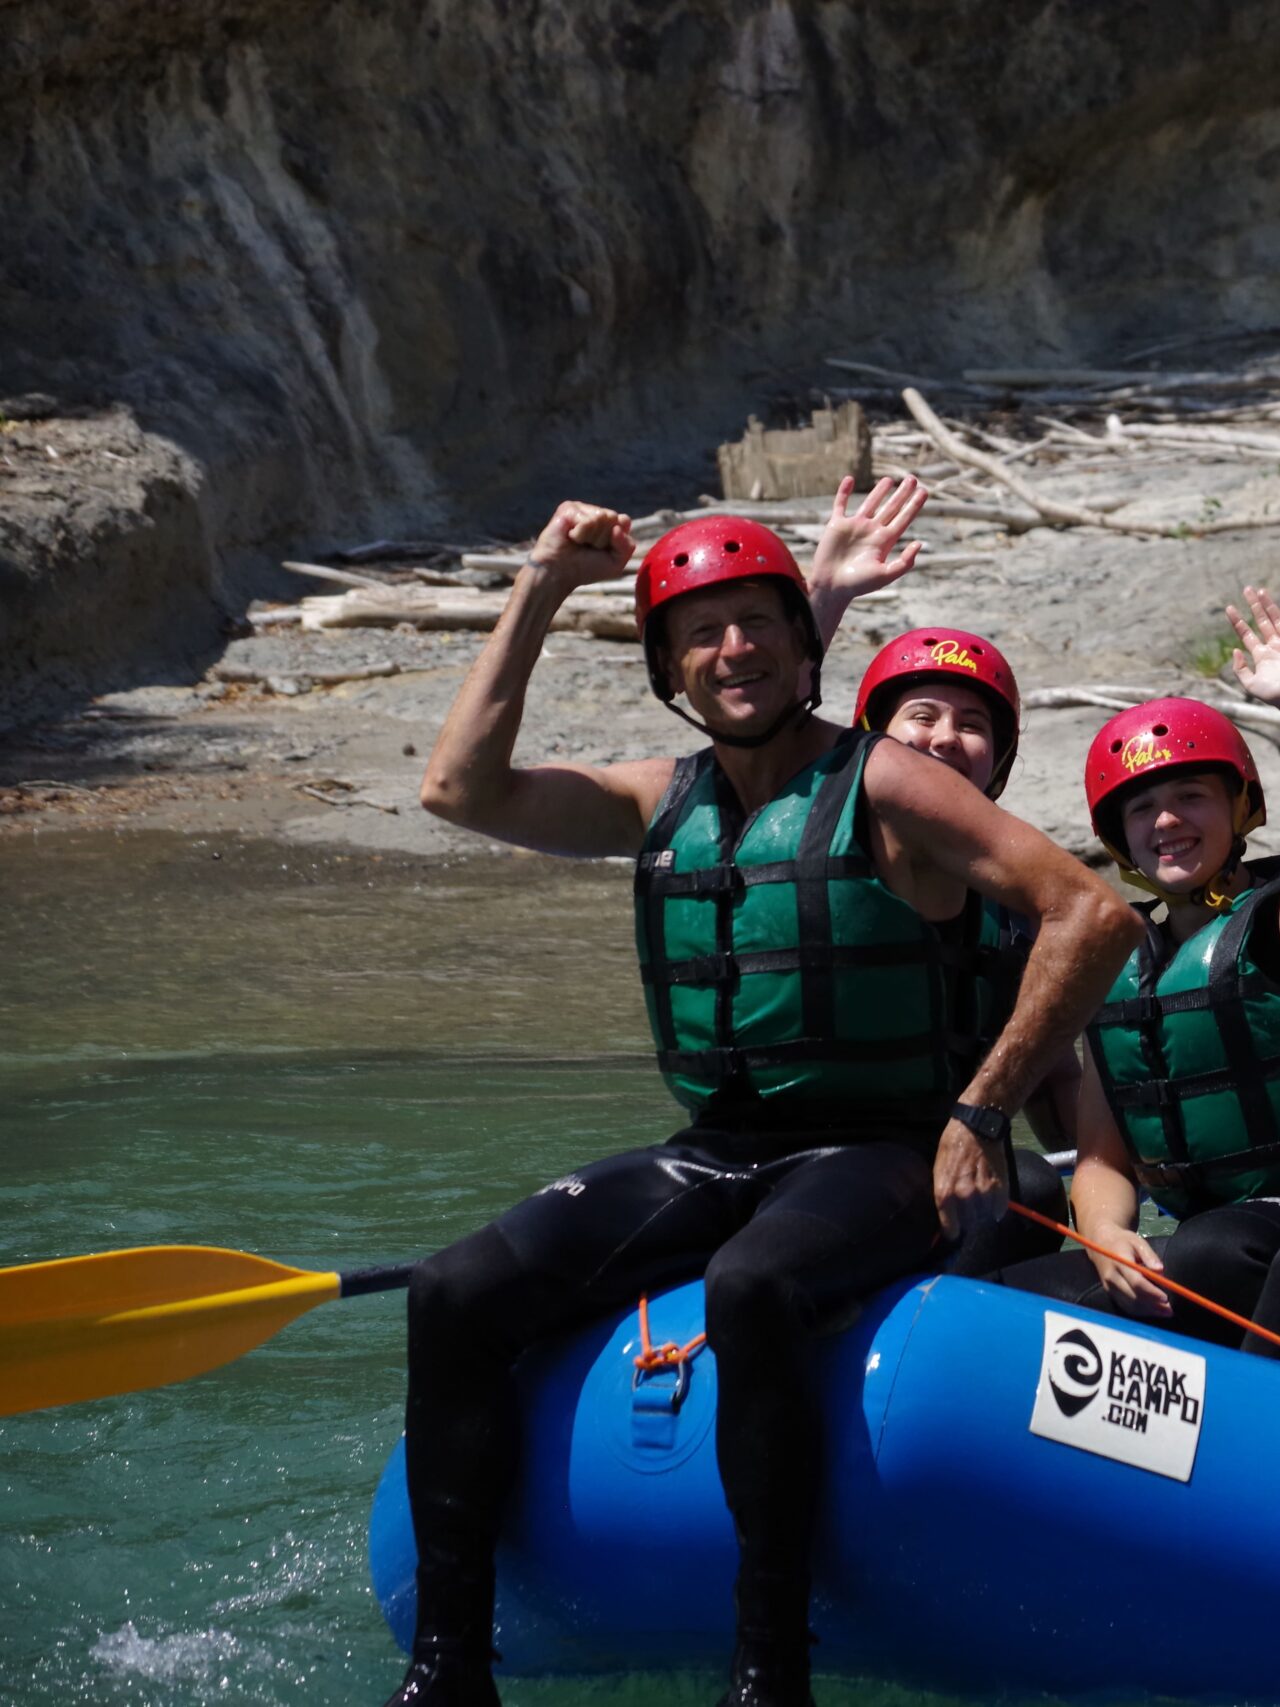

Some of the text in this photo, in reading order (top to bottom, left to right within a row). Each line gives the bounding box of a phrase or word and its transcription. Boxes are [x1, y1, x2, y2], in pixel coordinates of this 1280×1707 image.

[931, 640, 977, 673] Palm
[1110, 1351, 1188, 1396] KAYAK
[1101, 1404, 1149, 1434] .COM
[1107, 1377, 1200, 1425] CAMPO
